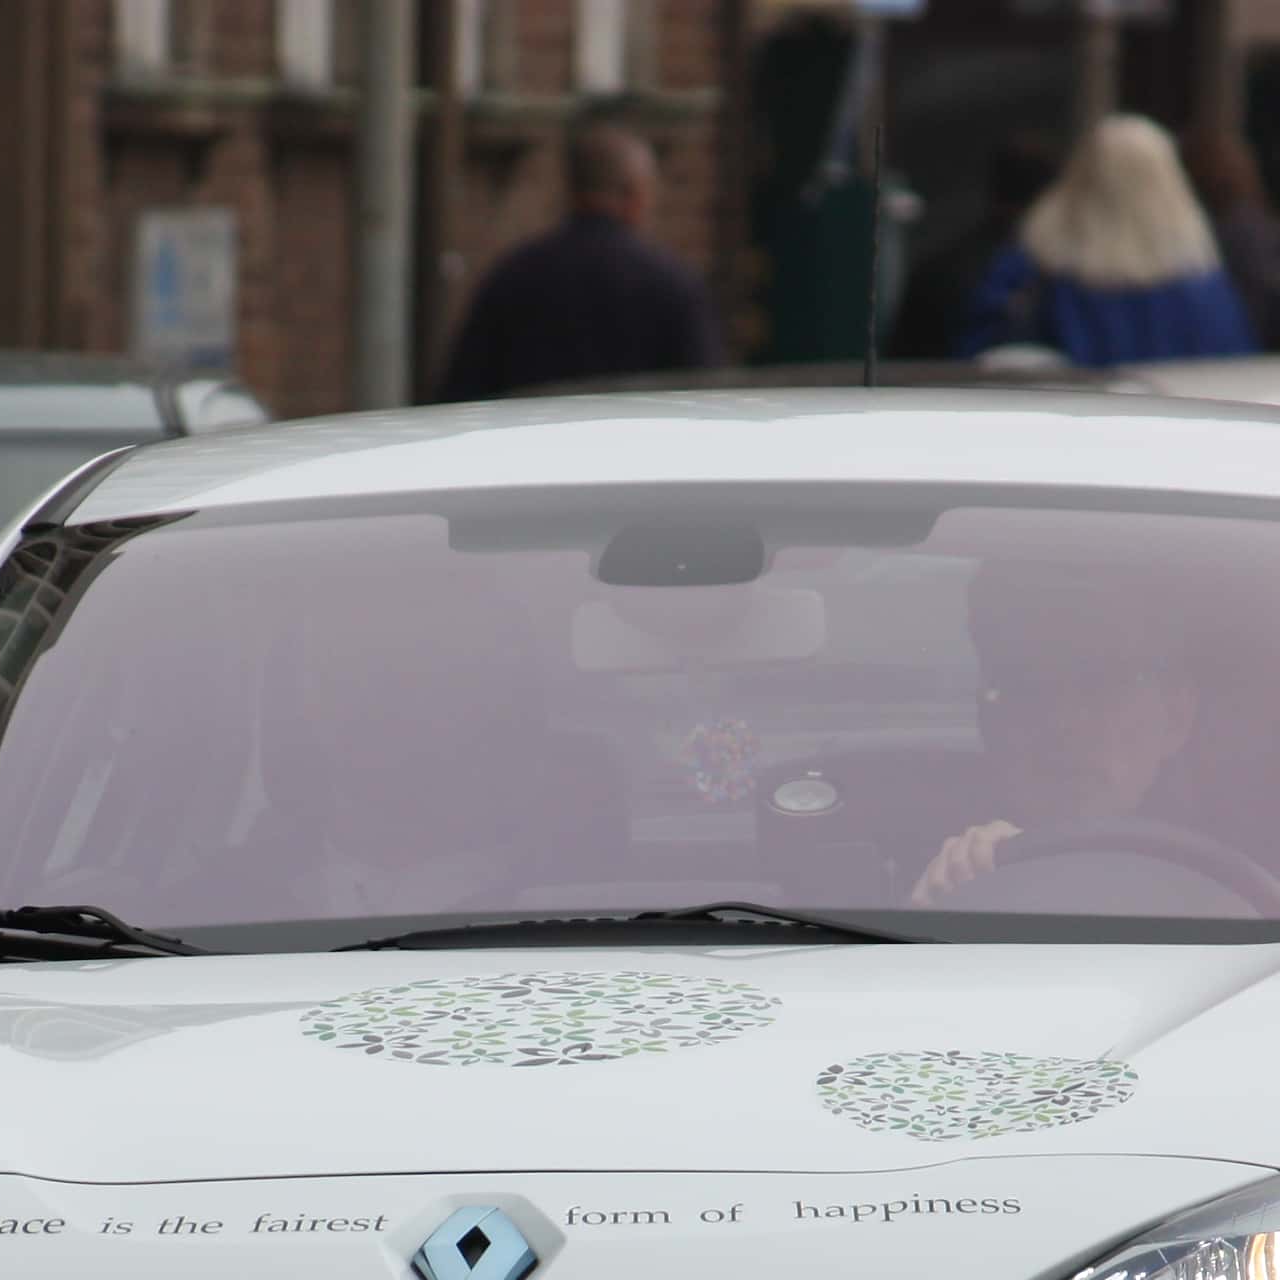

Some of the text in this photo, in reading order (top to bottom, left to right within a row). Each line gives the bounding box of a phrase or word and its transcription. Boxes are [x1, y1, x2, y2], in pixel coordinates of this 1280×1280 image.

[100, 1216, 133, 1235] is
[157, 1215, 224, 1235] the
[248, 1212, 390, 1234] fairest
[565, 1206, 672, 1226] form
[700, 1203, 744, 1225] of
[793, 1193, 1022, 1223] happiness
